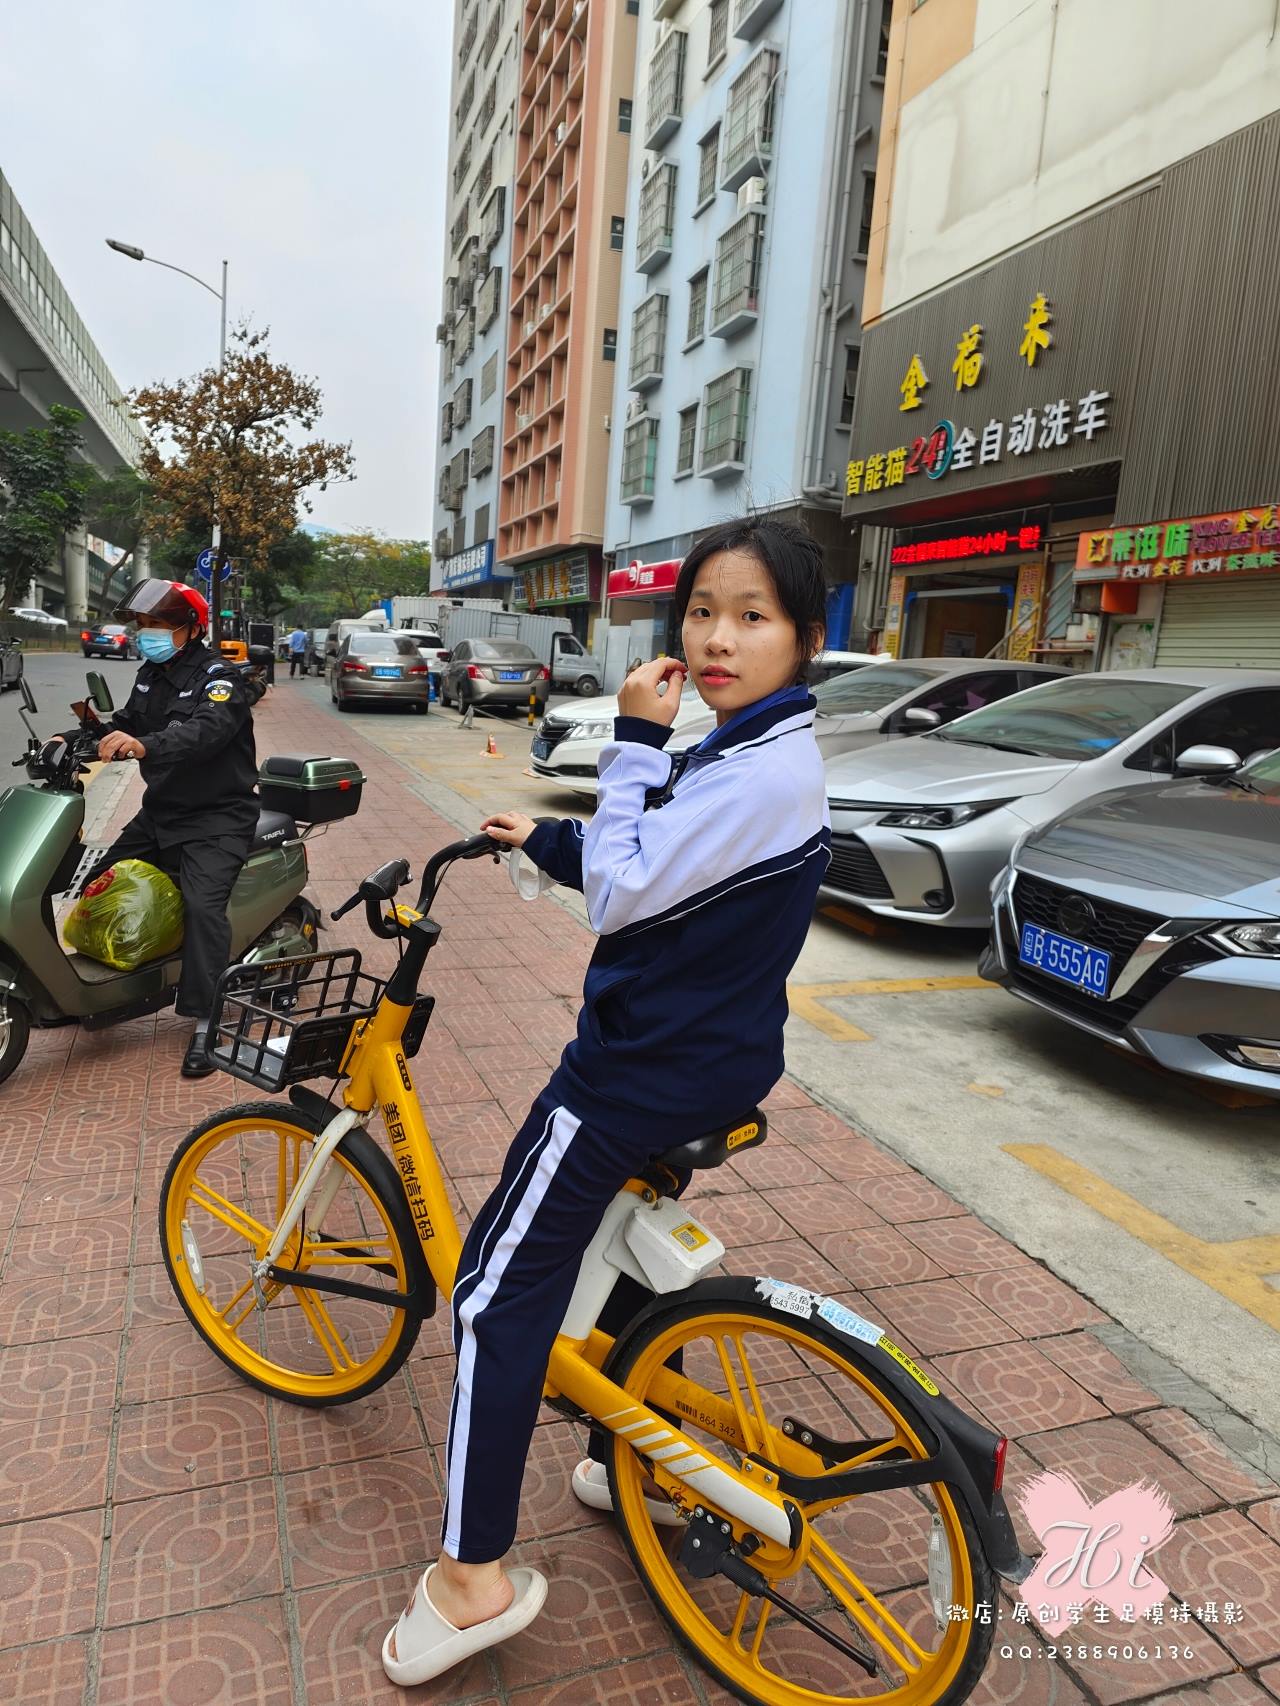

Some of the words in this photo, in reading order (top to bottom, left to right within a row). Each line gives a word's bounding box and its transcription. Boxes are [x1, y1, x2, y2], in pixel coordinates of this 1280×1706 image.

[846, 447, 907, 496] 智能猫
[950, 390, 1110, 470] 全自动洗车
[382, 1101, 407, 1144] 美团
[398, 1153, 435, 1241] 微信扫码
[699, 1412, 716, 1428] 864
[718, 1422, 736, 1439] 342
